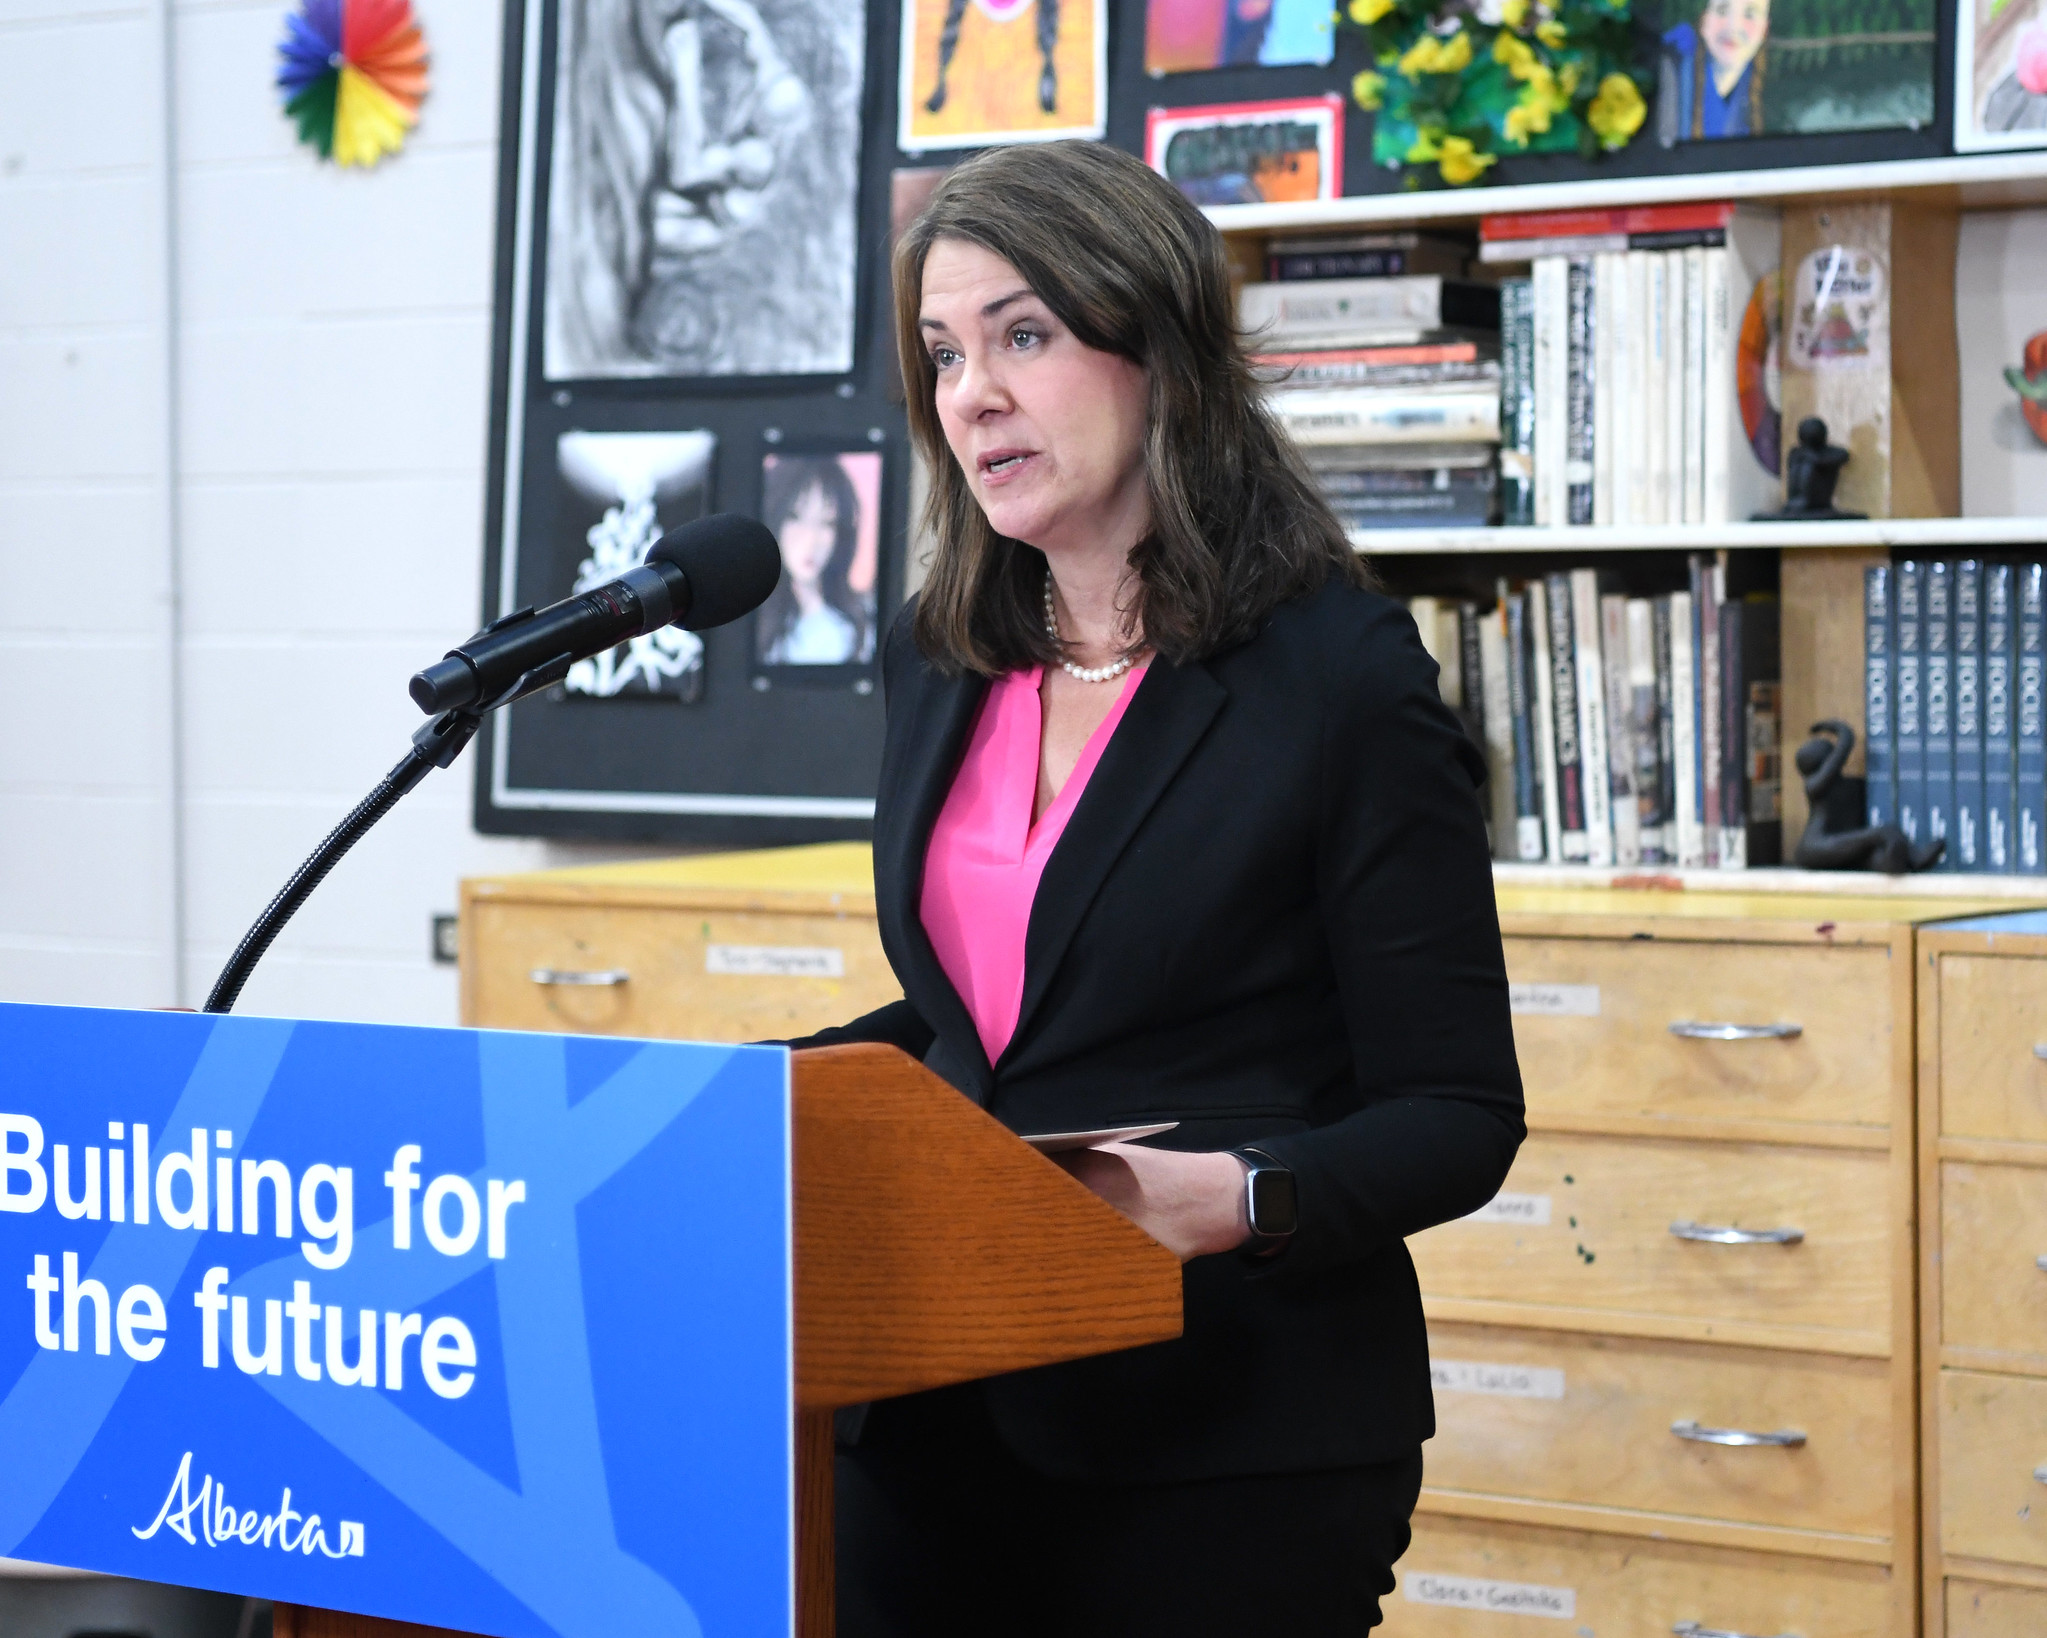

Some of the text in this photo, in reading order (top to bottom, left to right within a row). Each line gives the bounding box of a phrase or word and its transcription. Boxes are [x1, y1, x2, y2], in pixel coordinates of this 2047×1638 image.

[1869, 624, 1887, 654] IN
[1899, 573, 1919, 736] ART IN FOCUS
[1928, 573, 1948, 736] ART IN FOCUS
[1957, 573, 1977, 736] ART IN FOCUS
[1988, 622, 2007, 652] IN
[2022, 622, 2041, 652] IN
[1869, 657, 1887, 736] FOCUS
[1988, 656, 2007, 736] FOCUS
[2022, 656, 2041, 736] FOCUS
[0, 1113, 525, 1269] Building for
[27, 1252, 476, 1398] the future
[132, 1452, 347, 1558] Alberta
